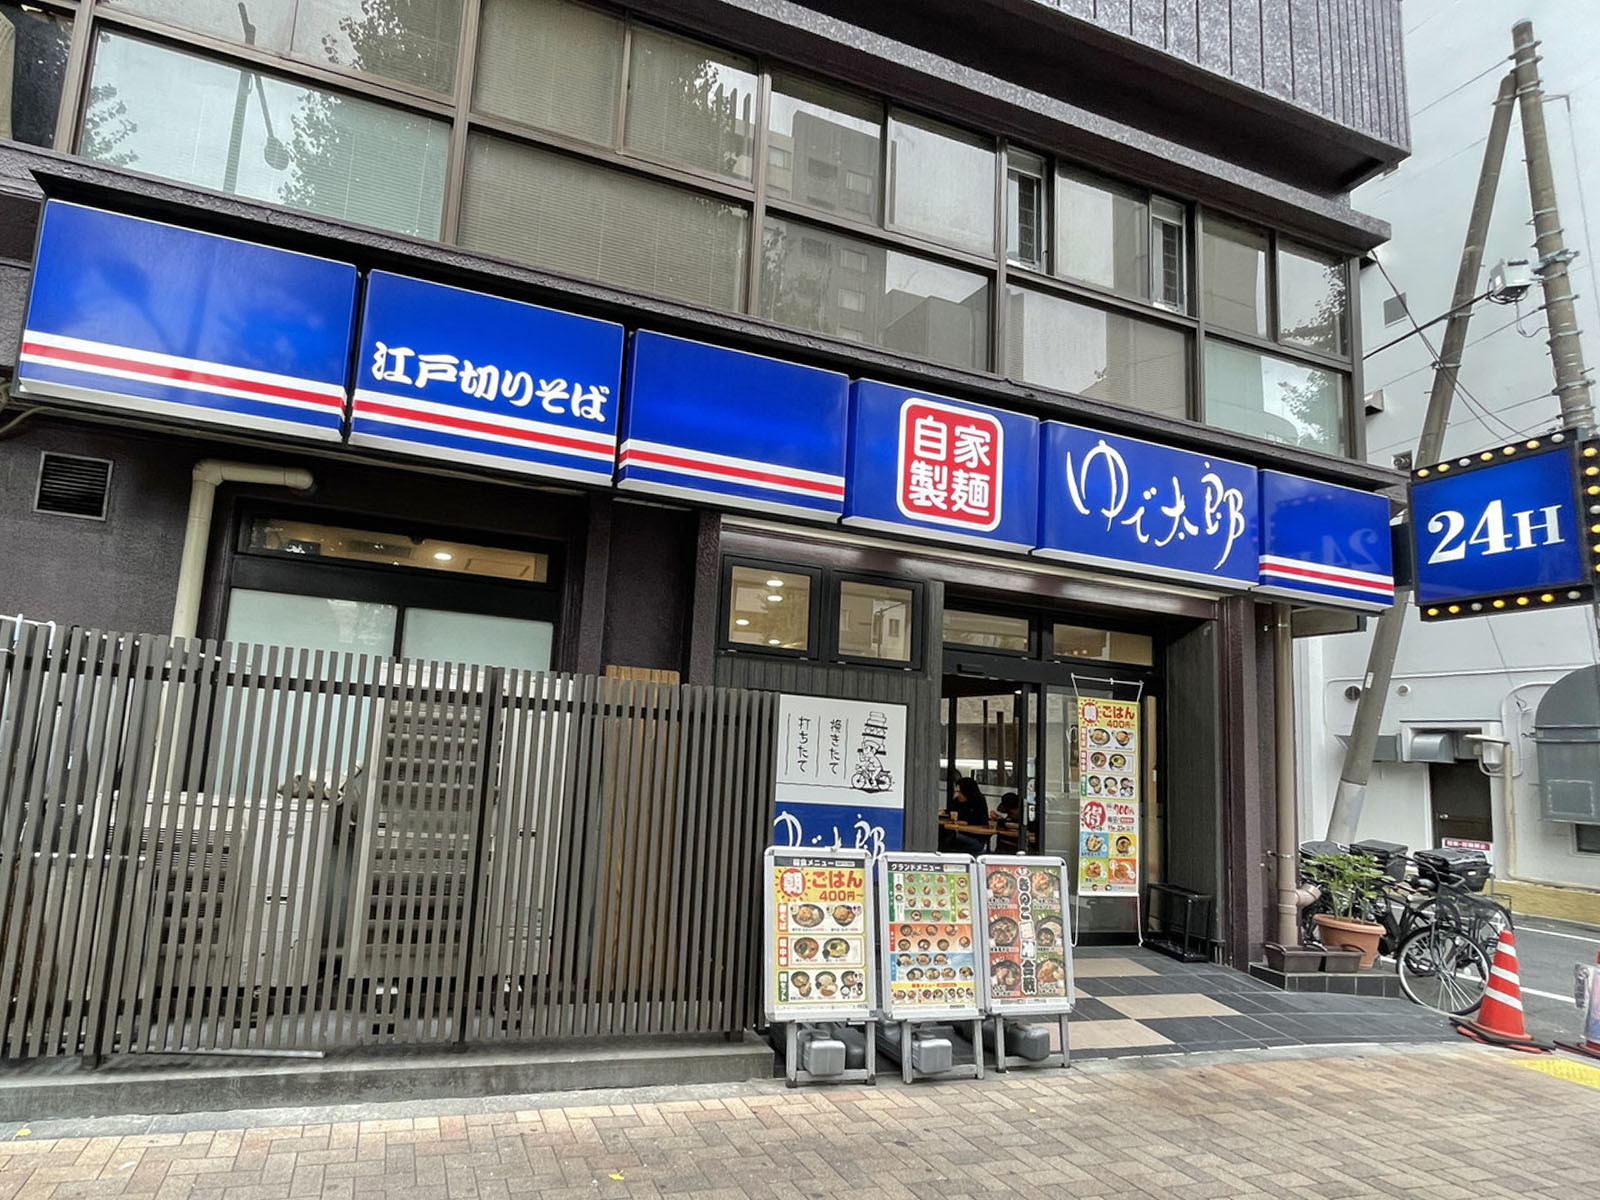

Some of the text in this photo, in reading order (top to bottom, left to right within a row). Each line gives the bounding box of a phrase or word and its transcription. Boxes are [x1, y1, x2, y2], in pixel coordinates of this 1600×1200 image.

[371, 341, 609, 422] 江戸切りそば
[914, 415, 991, 468] 自家
[908, 460, 989, 518] 製麺
[1066, 439, 1246, 571] ゆで太郎
[1427, 499, 1565, 565] 24H
[797, 715, 811, 773] 打ちたて
[891, 863, 941, 872] グランドメニュー
